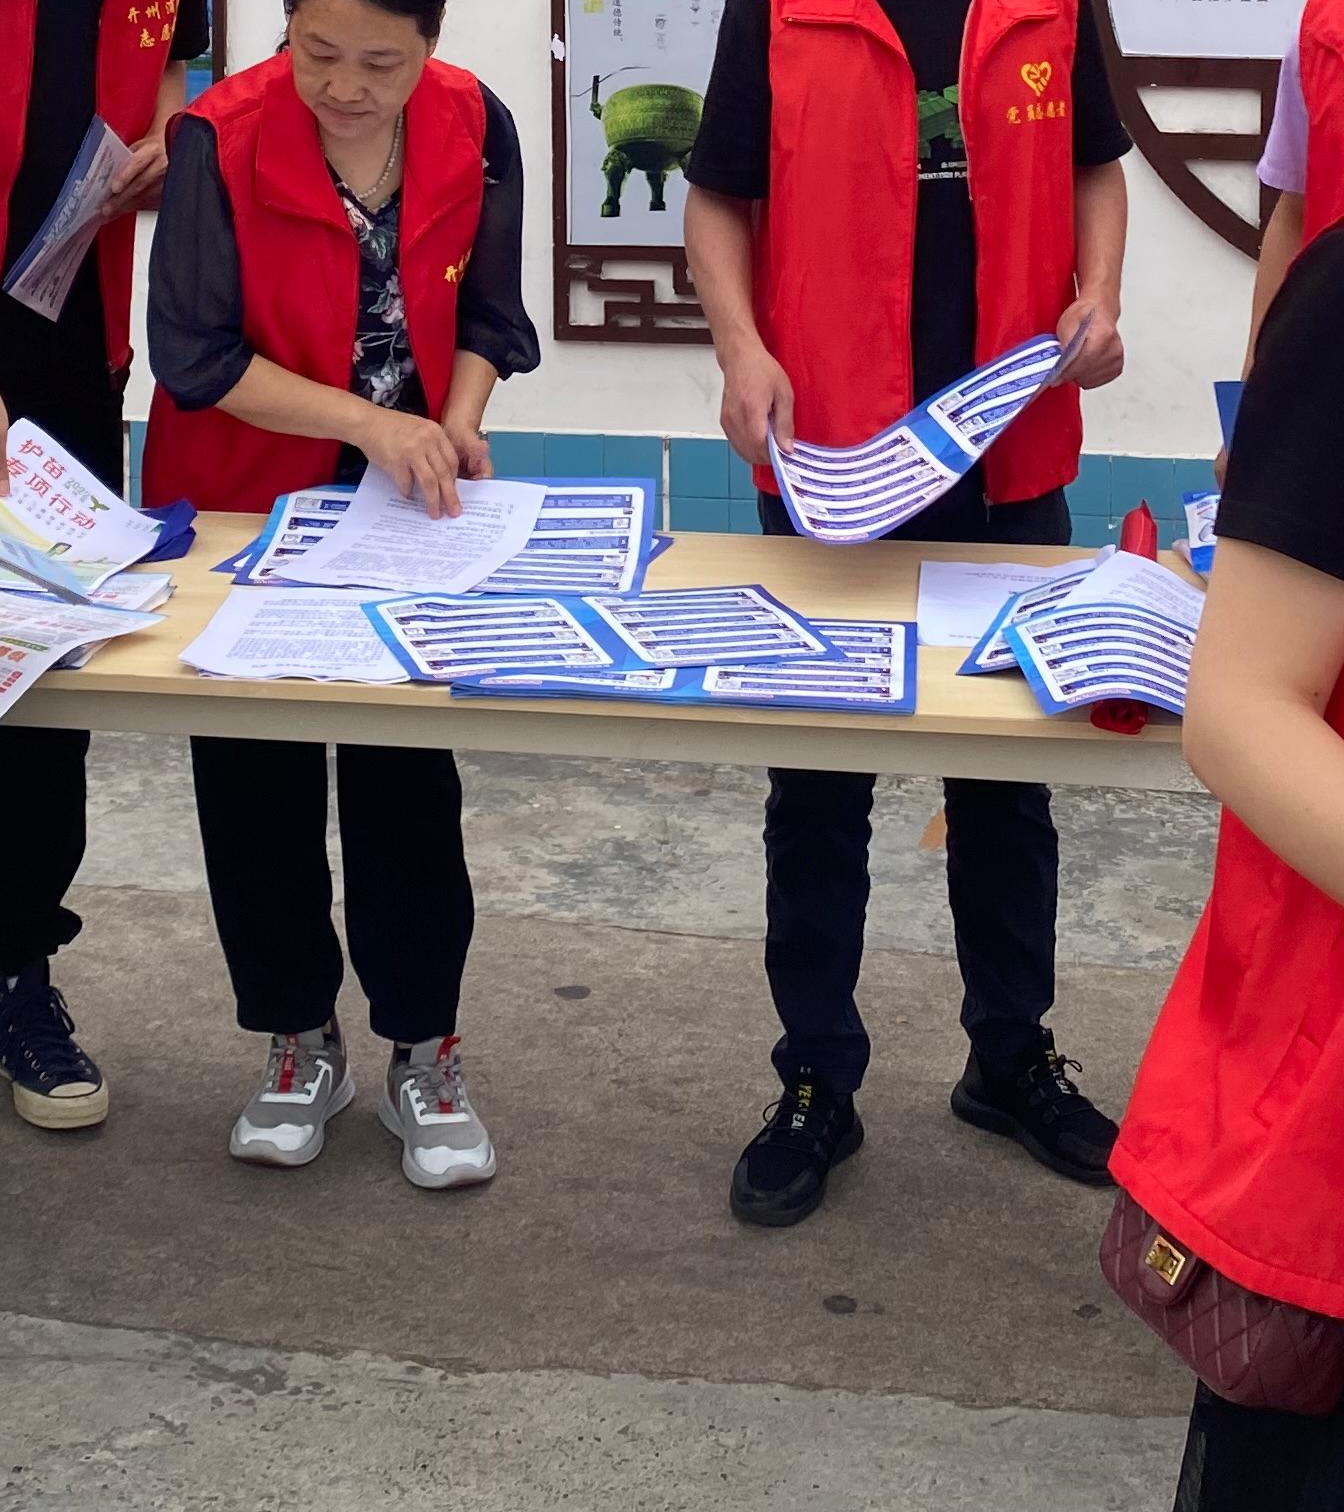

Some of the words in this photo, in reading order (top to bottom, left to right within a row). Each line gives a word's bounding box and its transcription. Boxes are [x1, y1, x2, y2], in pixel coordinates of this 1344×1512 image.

[19, 439, 67, 480] 护苗
[6, 456, 97, 530] 专项行动
